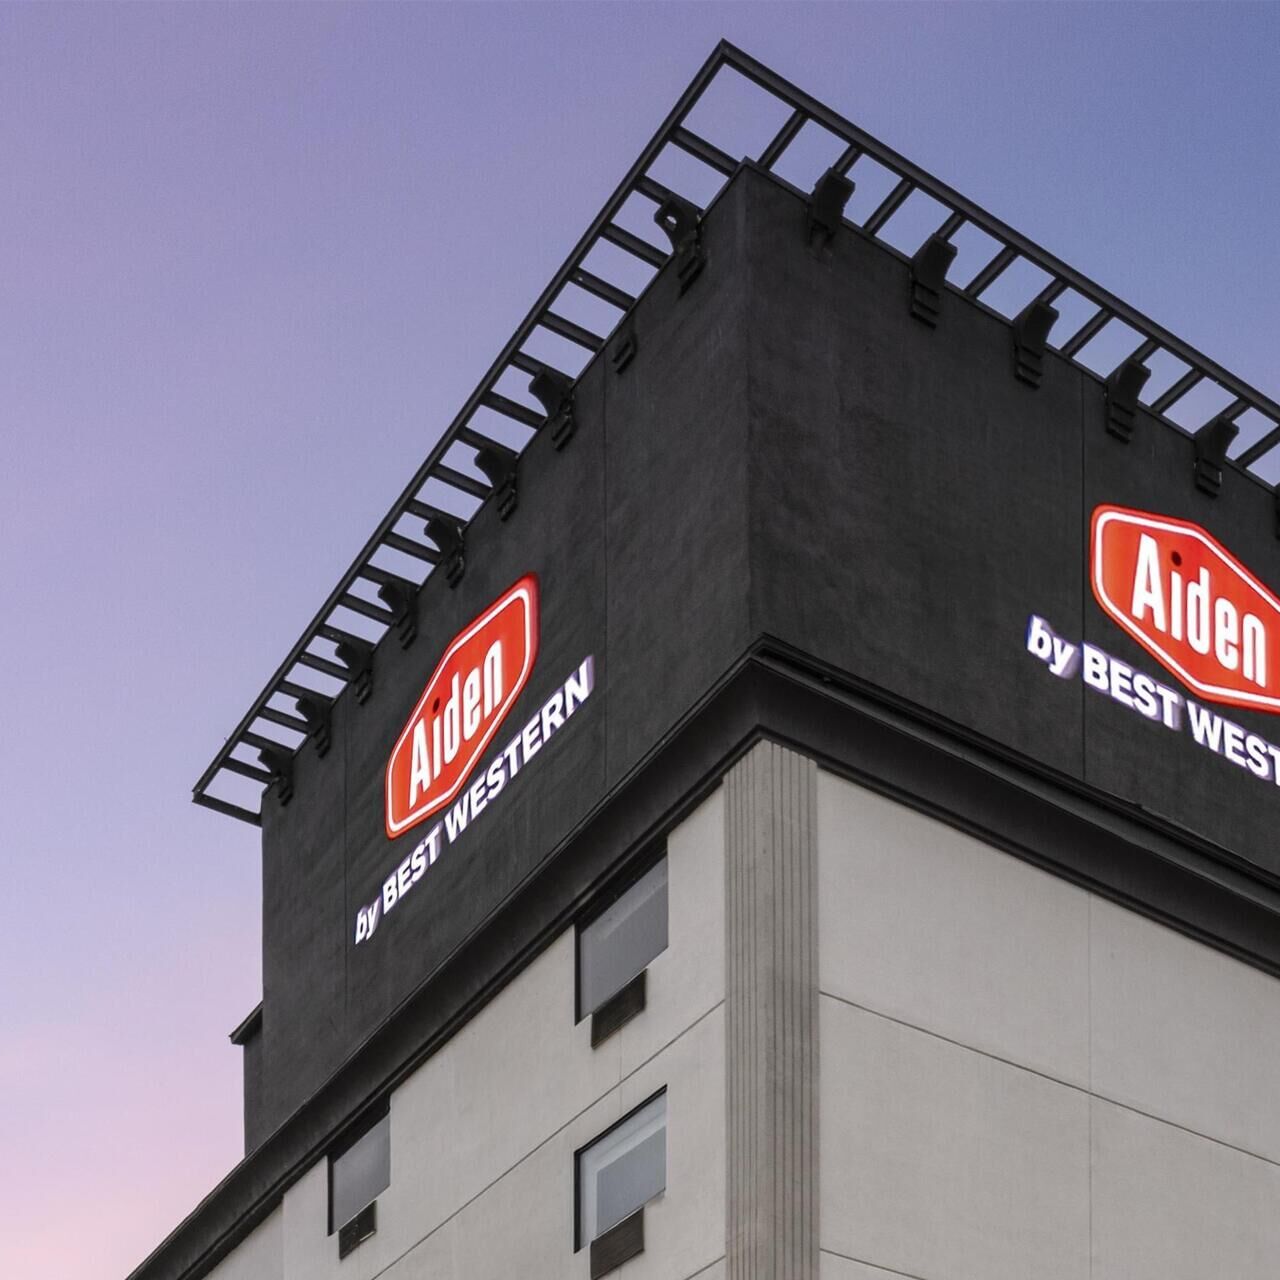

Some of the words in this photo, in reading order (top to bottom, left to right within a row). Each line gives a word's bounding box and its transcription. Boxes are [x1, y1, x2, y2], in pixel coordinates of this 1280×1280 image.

[1027, 614, 1077, 677] by
[1081, 641, 1181, 730] BEST
[1131, 532, 1266, 688] Aiden
[355, 898, 380, 945] by
[382, 823, 441, 915] BEST
[444, 655, 595, 844] WESTERN
[408, 639, 502, 809] Aiden
